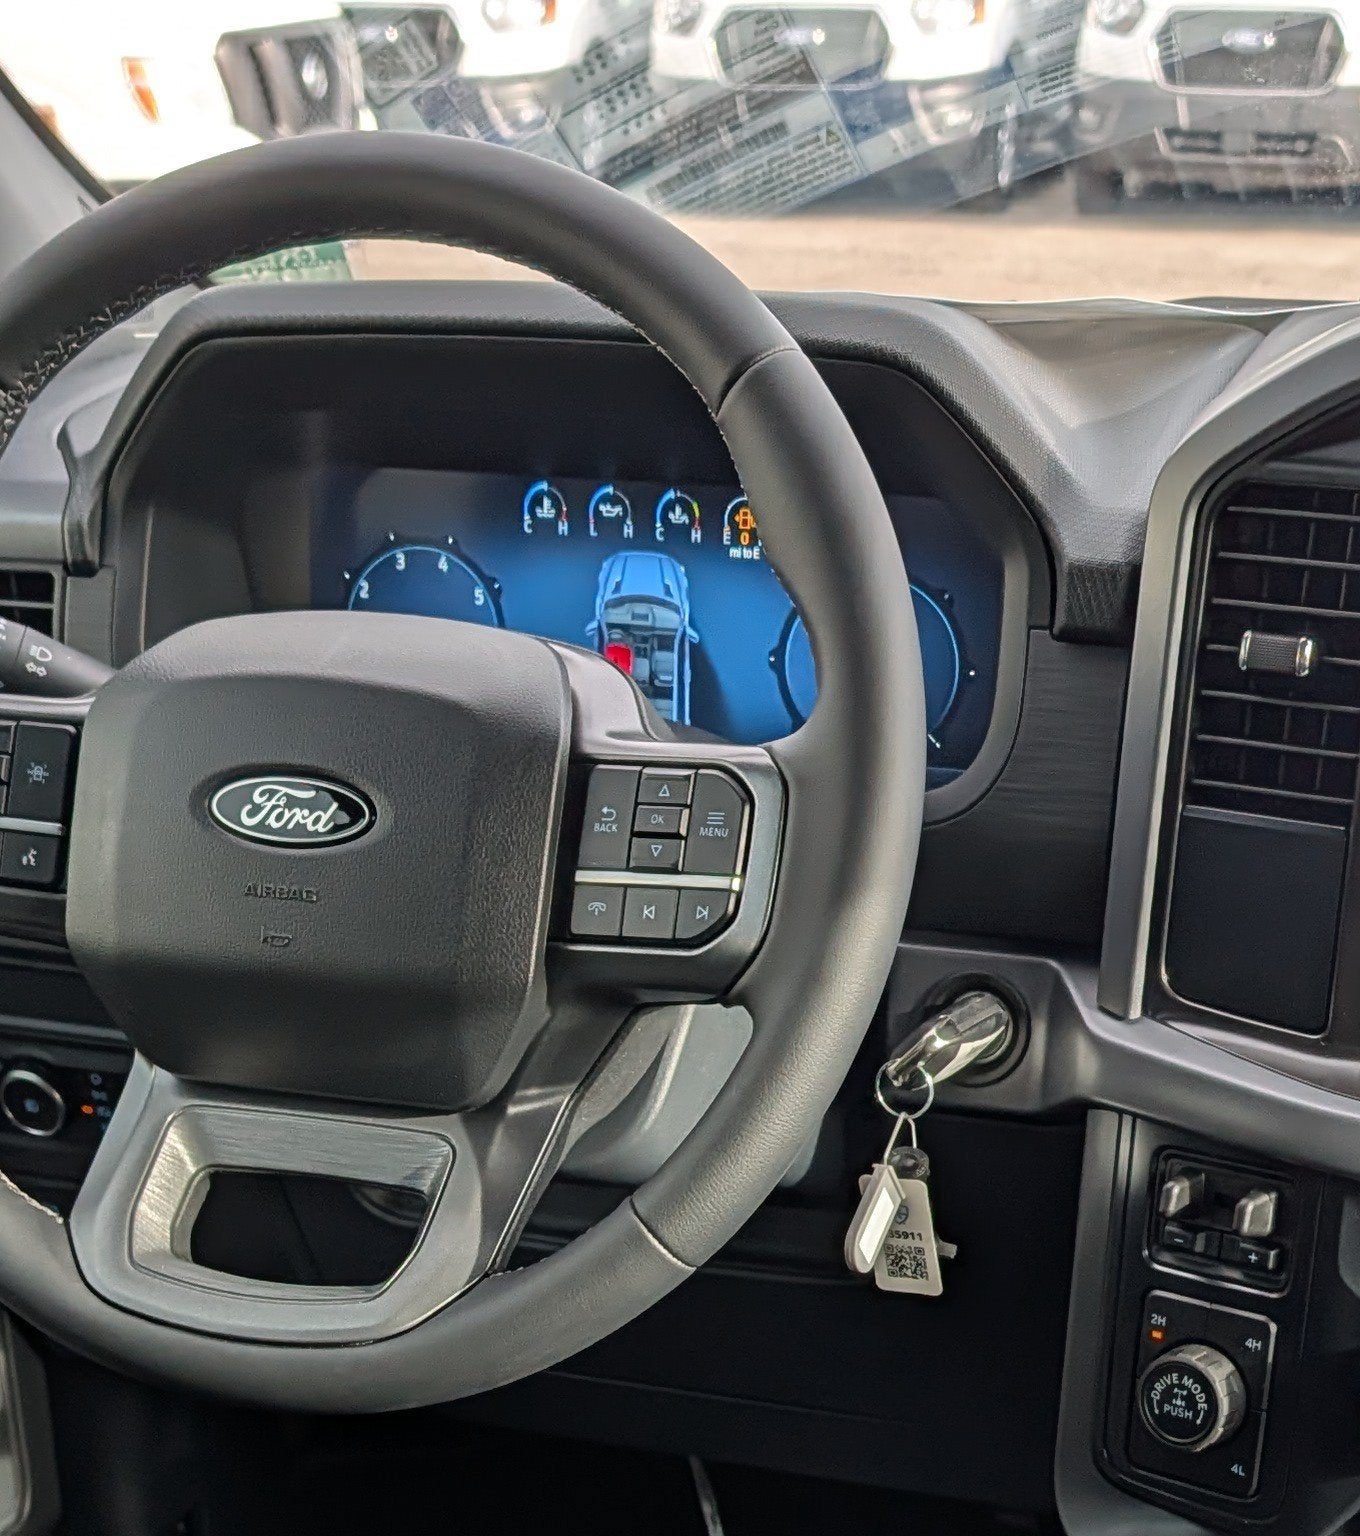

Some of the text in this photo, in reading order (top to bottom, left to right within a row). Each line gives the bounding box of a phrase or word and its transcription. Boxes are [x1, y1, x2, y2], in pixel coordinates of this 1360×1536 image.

[524, 519, 533, 533] C
[558, 520, 569, 536] H
[589, 521, 599, 537] L
[623, 522, 634, 539] H
[655, 526, 665, 542] C
[691, 527, 702, 544] H
[723, 529, 731, 545] E
[753, 546, 761, 560] E
[395, 552, 406, 571] 3
[438, 555, 449, 572] 4
[359, 579, 369, 599] 2
[474, 587, 485, 607] 5
[240, 784, 339, 833] Ford
[650, 814, 664, 825] OK
[593, 823, 619, 833] BACK
[698, 827, 730, 838] MENU
[243, 881, 318, 904] AIRBAG
[1150, 1313, 1167, 1327] 2H
[1245, 1337, 1262, 1352] 4H
[1150, 1373, 1208, 1411] DRIVE MODE
[1163, 1403, 1193, 1420] PUSH
[1230, 1463, 1245, 1477] 4L
